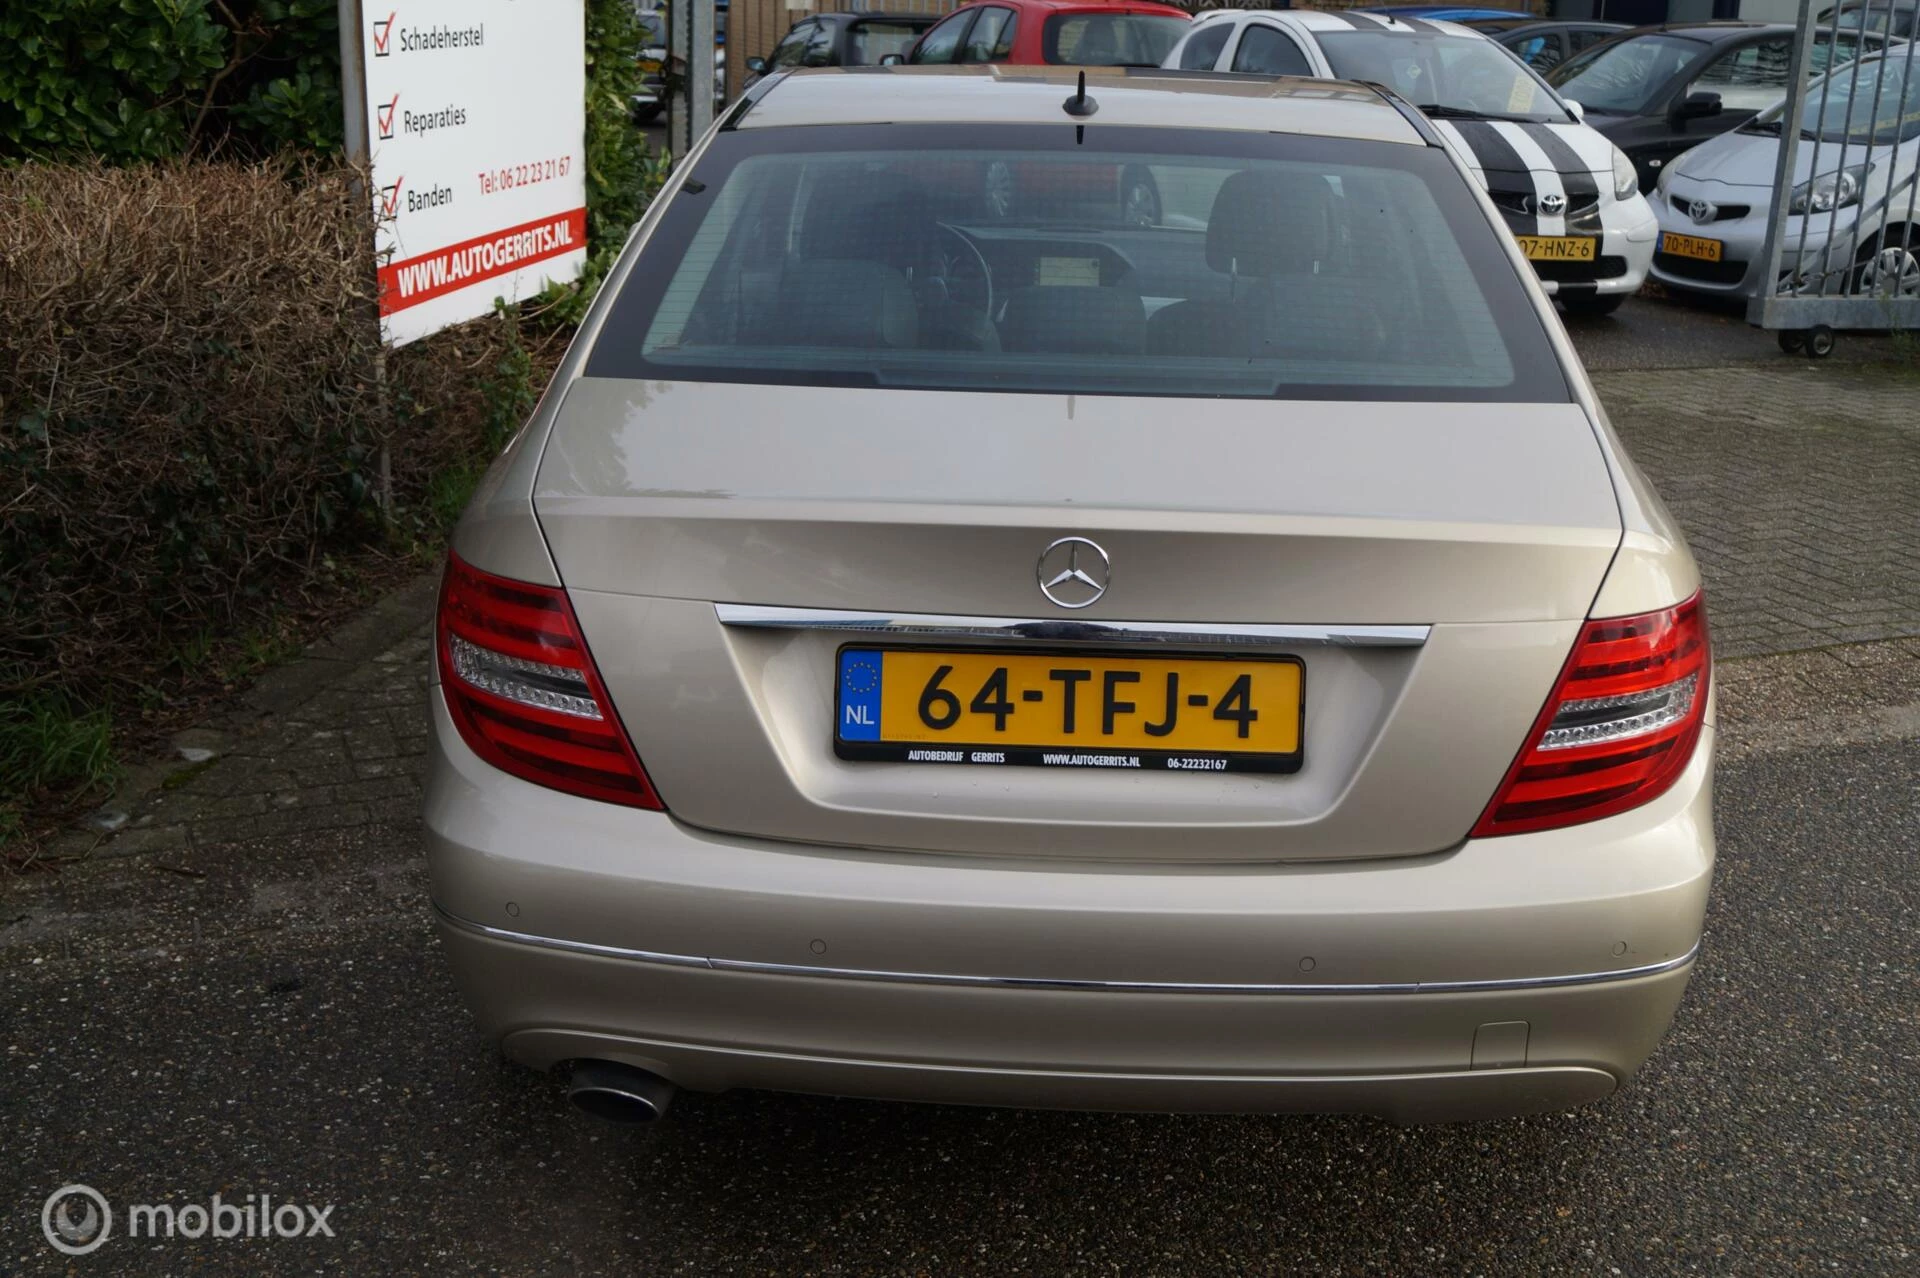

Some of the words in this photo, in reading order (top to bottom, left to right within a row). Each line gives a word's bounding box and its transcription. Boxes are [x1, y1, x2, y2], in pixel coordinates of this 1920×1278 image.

[400, 24, 484, 52] Schadeherstel
[404, 104, 466, 137] Reparaties
[479, 170, 498, 195] Tel:
[500, 168, 513, 190] 06
[516, 165, 528, 186] 22
[531, 162, 543, 183] 23
[545, 159, 556, 180] 21
[559, 156, 571, 176] 67
[408, 184, 452, 212] Banden
[397, 220, 573, 297] WWW.AUTOGERRITS.NL
[1665, 235, 1716, 258] 70-PLH-6
[845, 705, 875, 725] NL
[917, 665, 1258, 739] 64-TFJ-4
[908, 750, 964, 763] AUTOBEDRIJF
[971, 751, 1005, 764] GERRITS
[1043, 754, 1141, 768] WWW.AUTOGERRITS.NL
[1167, 758, 1227, 770] 06-22232167
